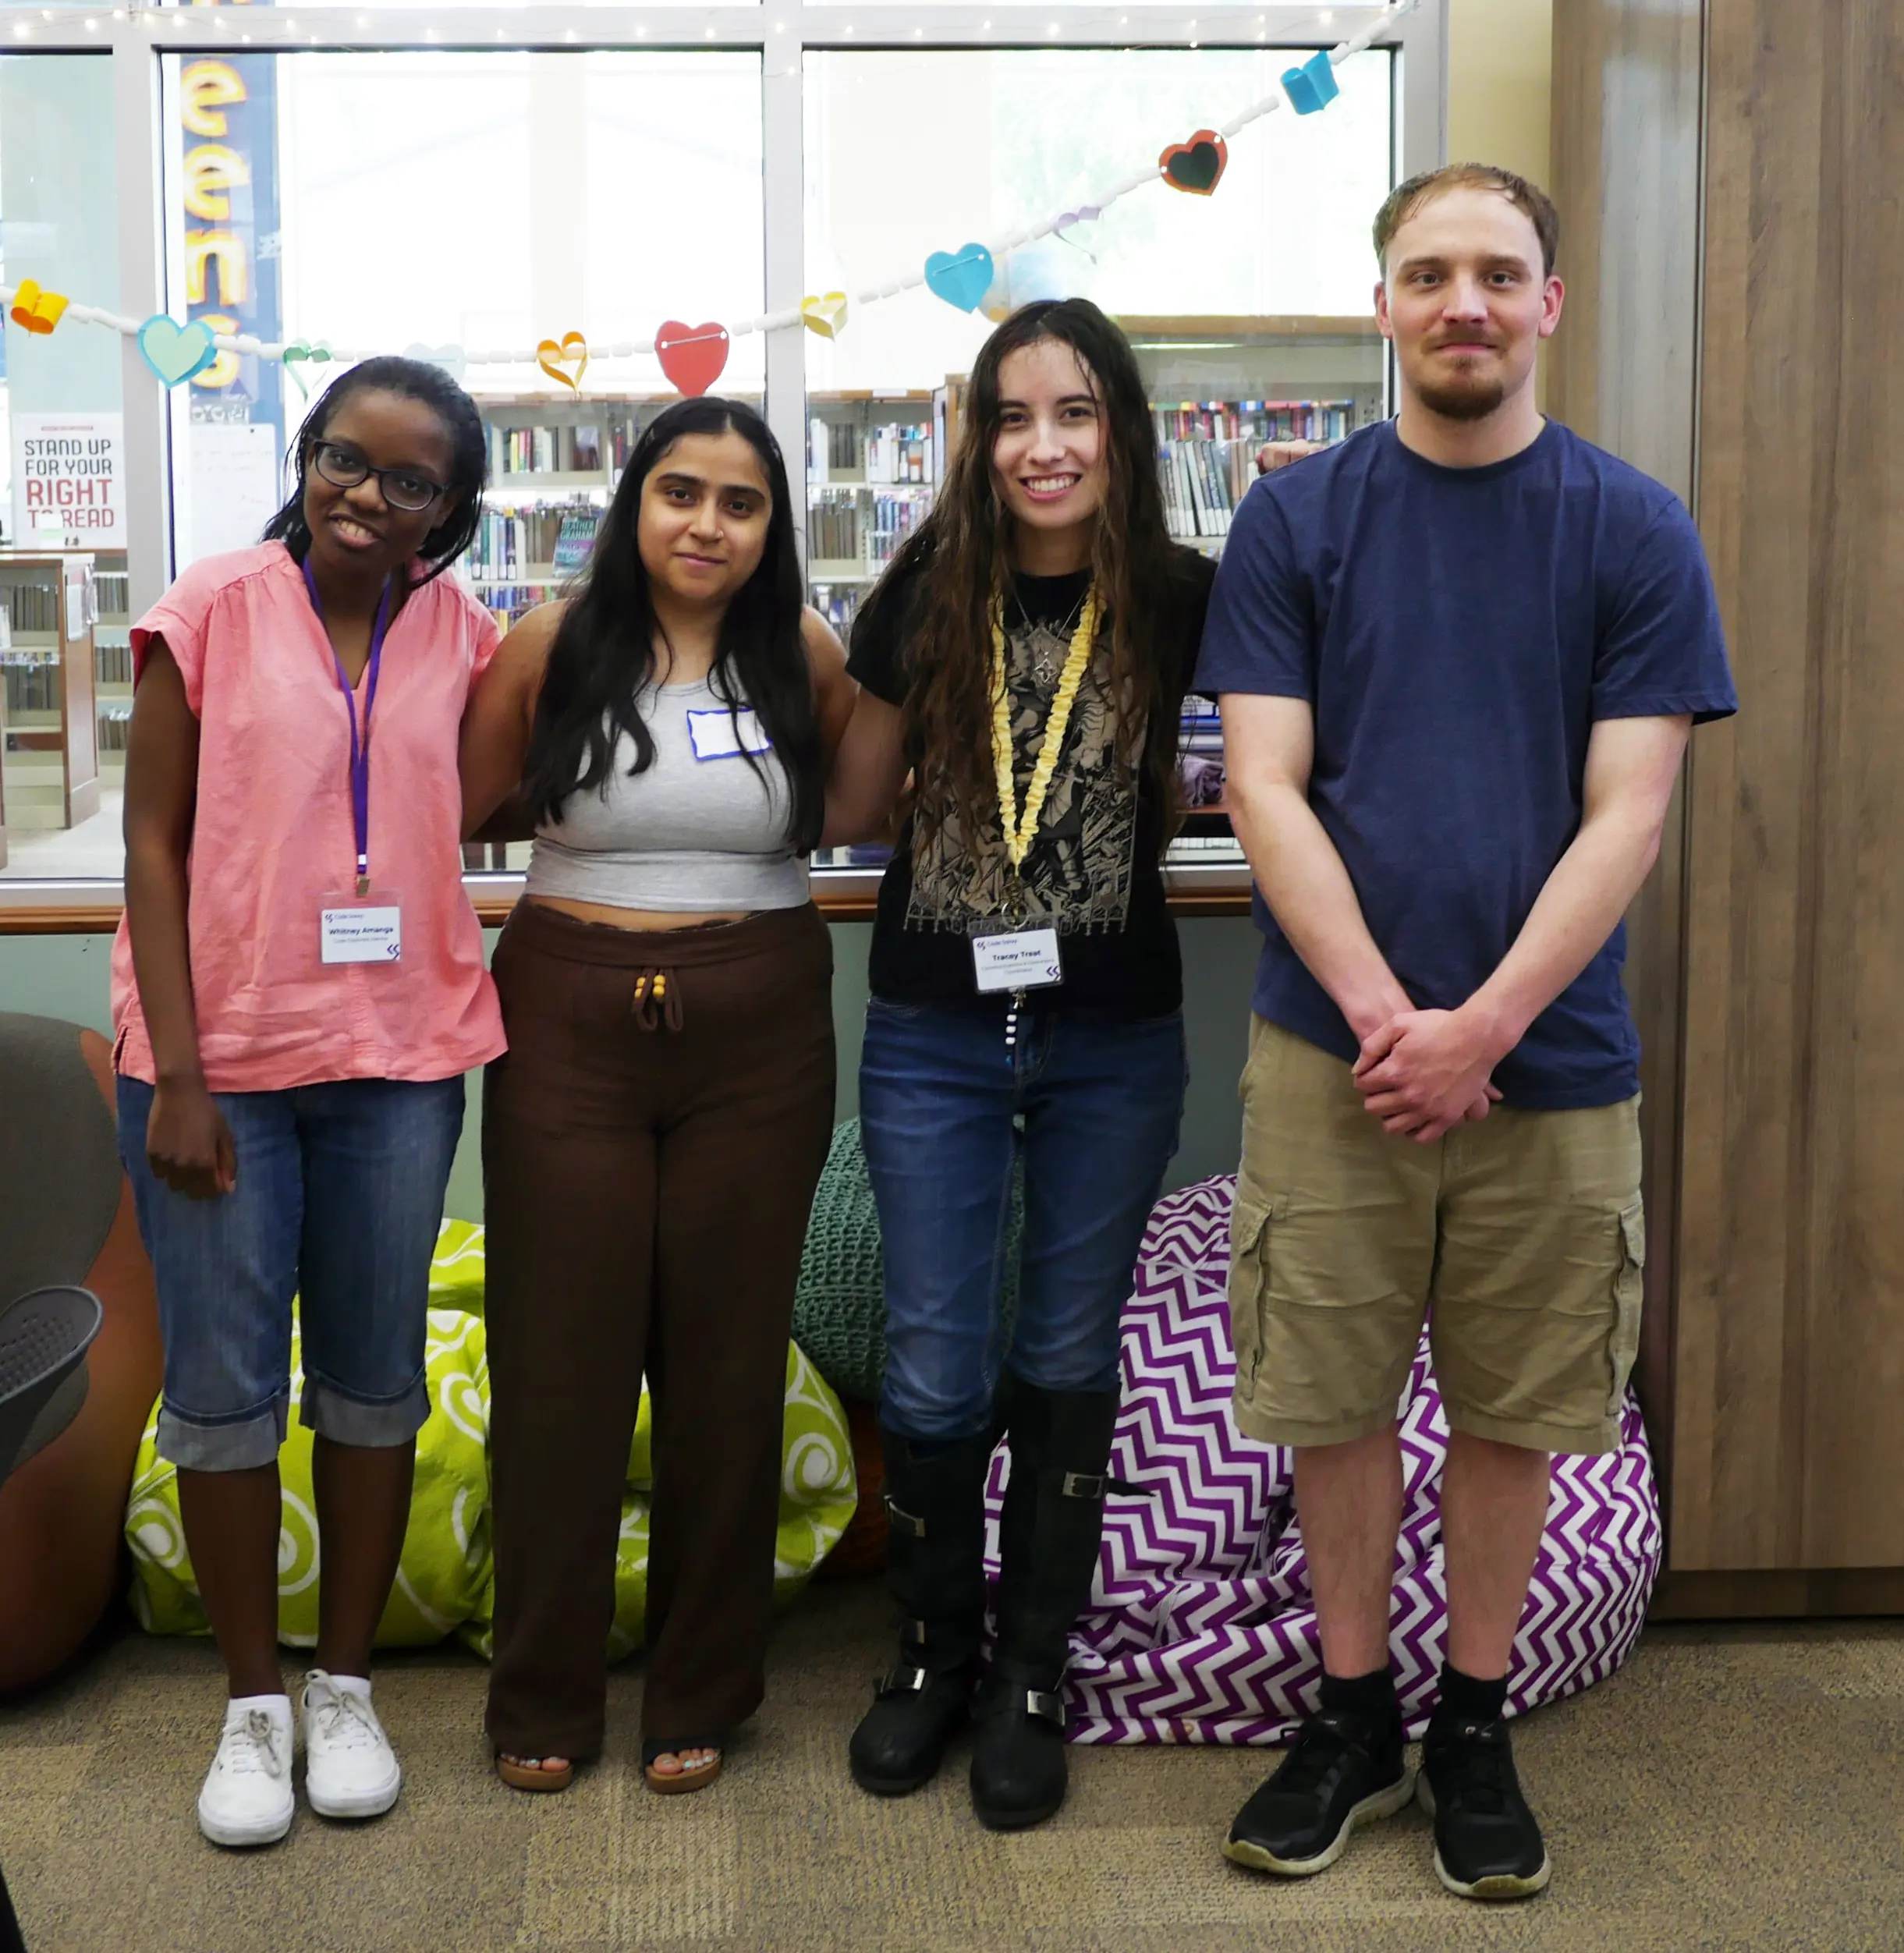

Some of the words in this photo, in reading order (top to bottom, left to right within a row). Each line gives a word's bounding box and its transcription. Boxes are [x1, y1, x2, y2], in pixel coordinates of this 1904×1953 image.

[180, 0, 250, 388] eens
[25, 439, 82, 455] STAND
[88, 438, 111, 455] UP
[25, 459, 59, 476] FOR
[65, 459, 112, 475] YOUR
[27, 479, 112, 505] RIGHT
[27, 509, 53, 529] T
[60, 509, 115, 528] READ
